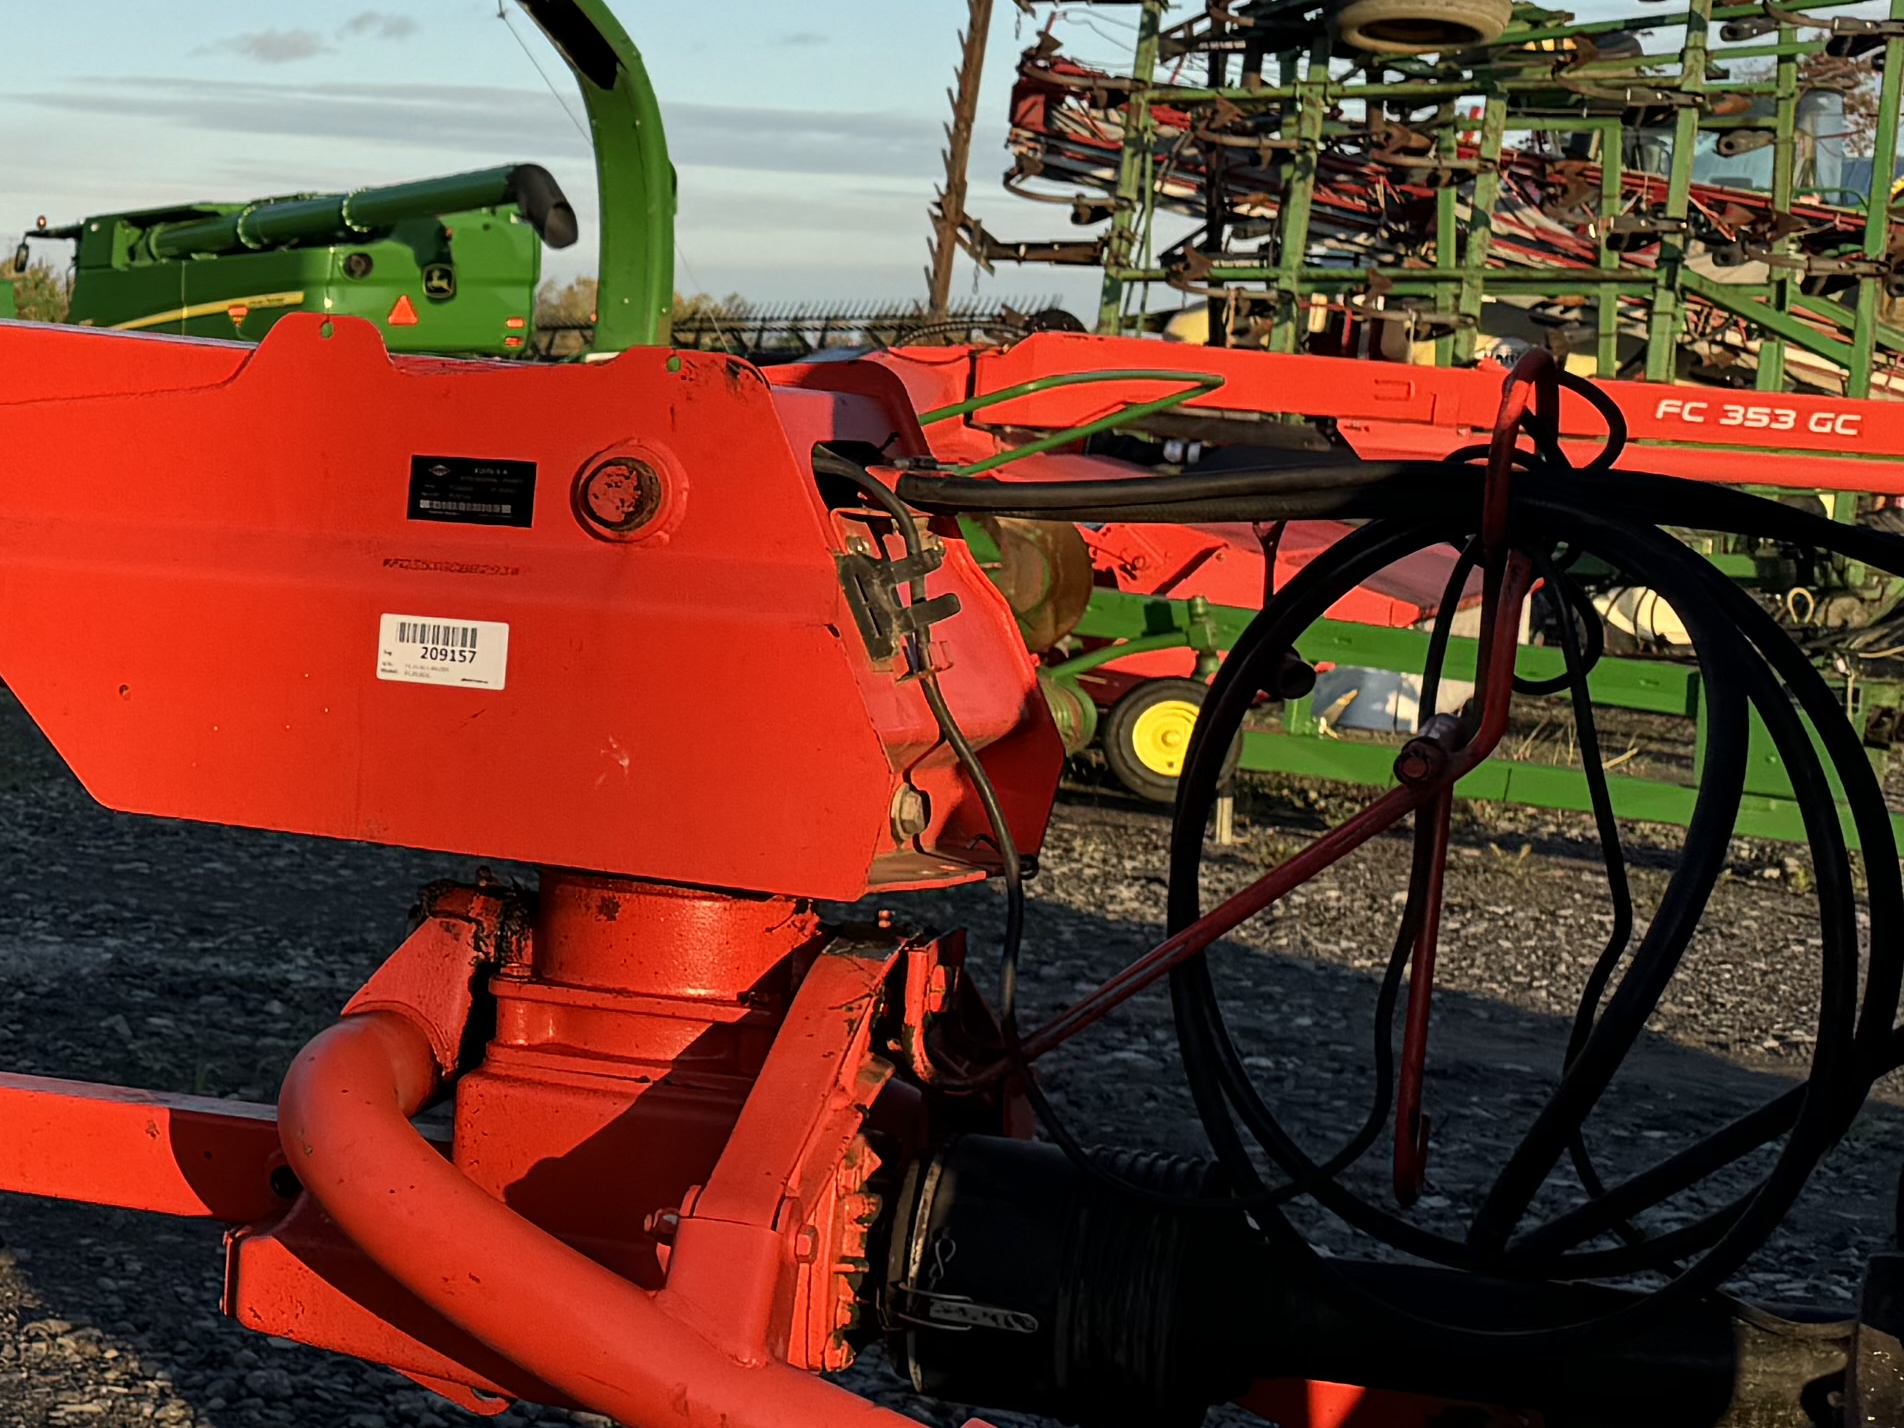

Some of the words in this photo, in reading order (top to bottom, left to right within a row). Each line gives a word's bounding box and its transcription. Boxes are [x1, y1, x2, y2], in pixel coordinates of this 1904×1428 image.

[1655, 398, 1708, 423] FC
[1719, 403, 1797, 430] 353
[1807, 411, 1862, 436] GC
[420, 646, 478, 664] 209157
